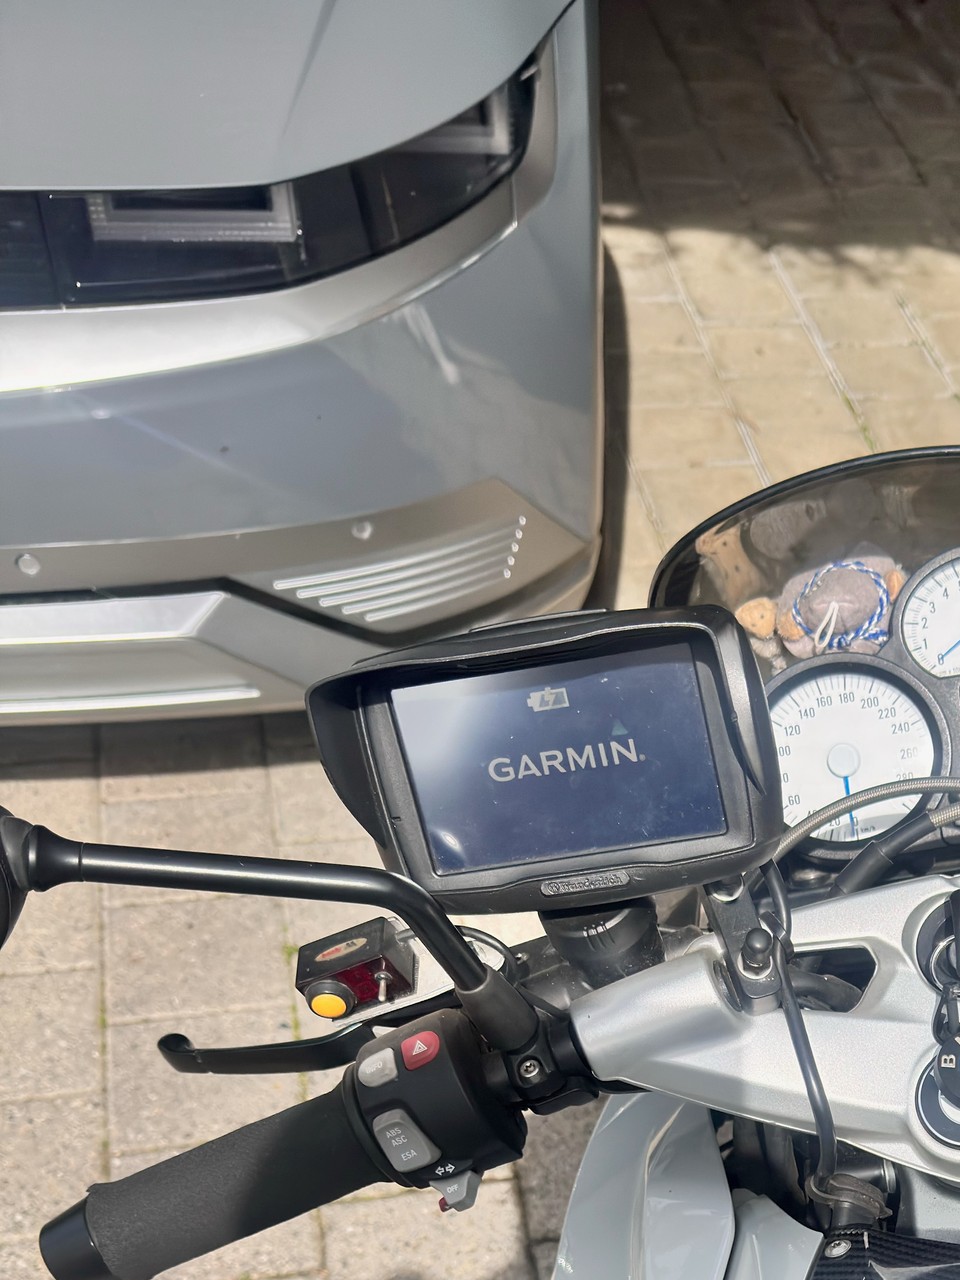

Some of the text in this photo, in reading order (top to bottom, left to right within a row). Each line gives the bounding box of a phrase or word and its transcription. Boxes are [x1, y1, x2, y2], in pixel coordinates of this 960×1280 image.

[942, 588, 949, 600] 4
[929, 602, 936, 613] 3
[921, 617, 928, 629] 2
[923, 638, 928, 649] 1
[816, 696, 833, 708] 160
[838, 692, 855, 704] 180
[860, 696, 879, 709] 200
[799, 707, 815, 720] 140
[878, 707, 896, 720] 220
[784, 724, 801, 736] 120
[891, 722, 910, 735] 240
[778, 746, 791, 757] 00
[900, 747, 918, 760] 260
[487, 738, 639, 783] GARMIN
[788, 794, 801, 806] 60
[366, 1061, 383, 1074] INFO
[385, 1127, 402, 1139] ABS
[391, 1135, 408, 1147] ASC
[401, 1149, 417, 1161] ESA
[446, 1183, 459, 1194] OFF
